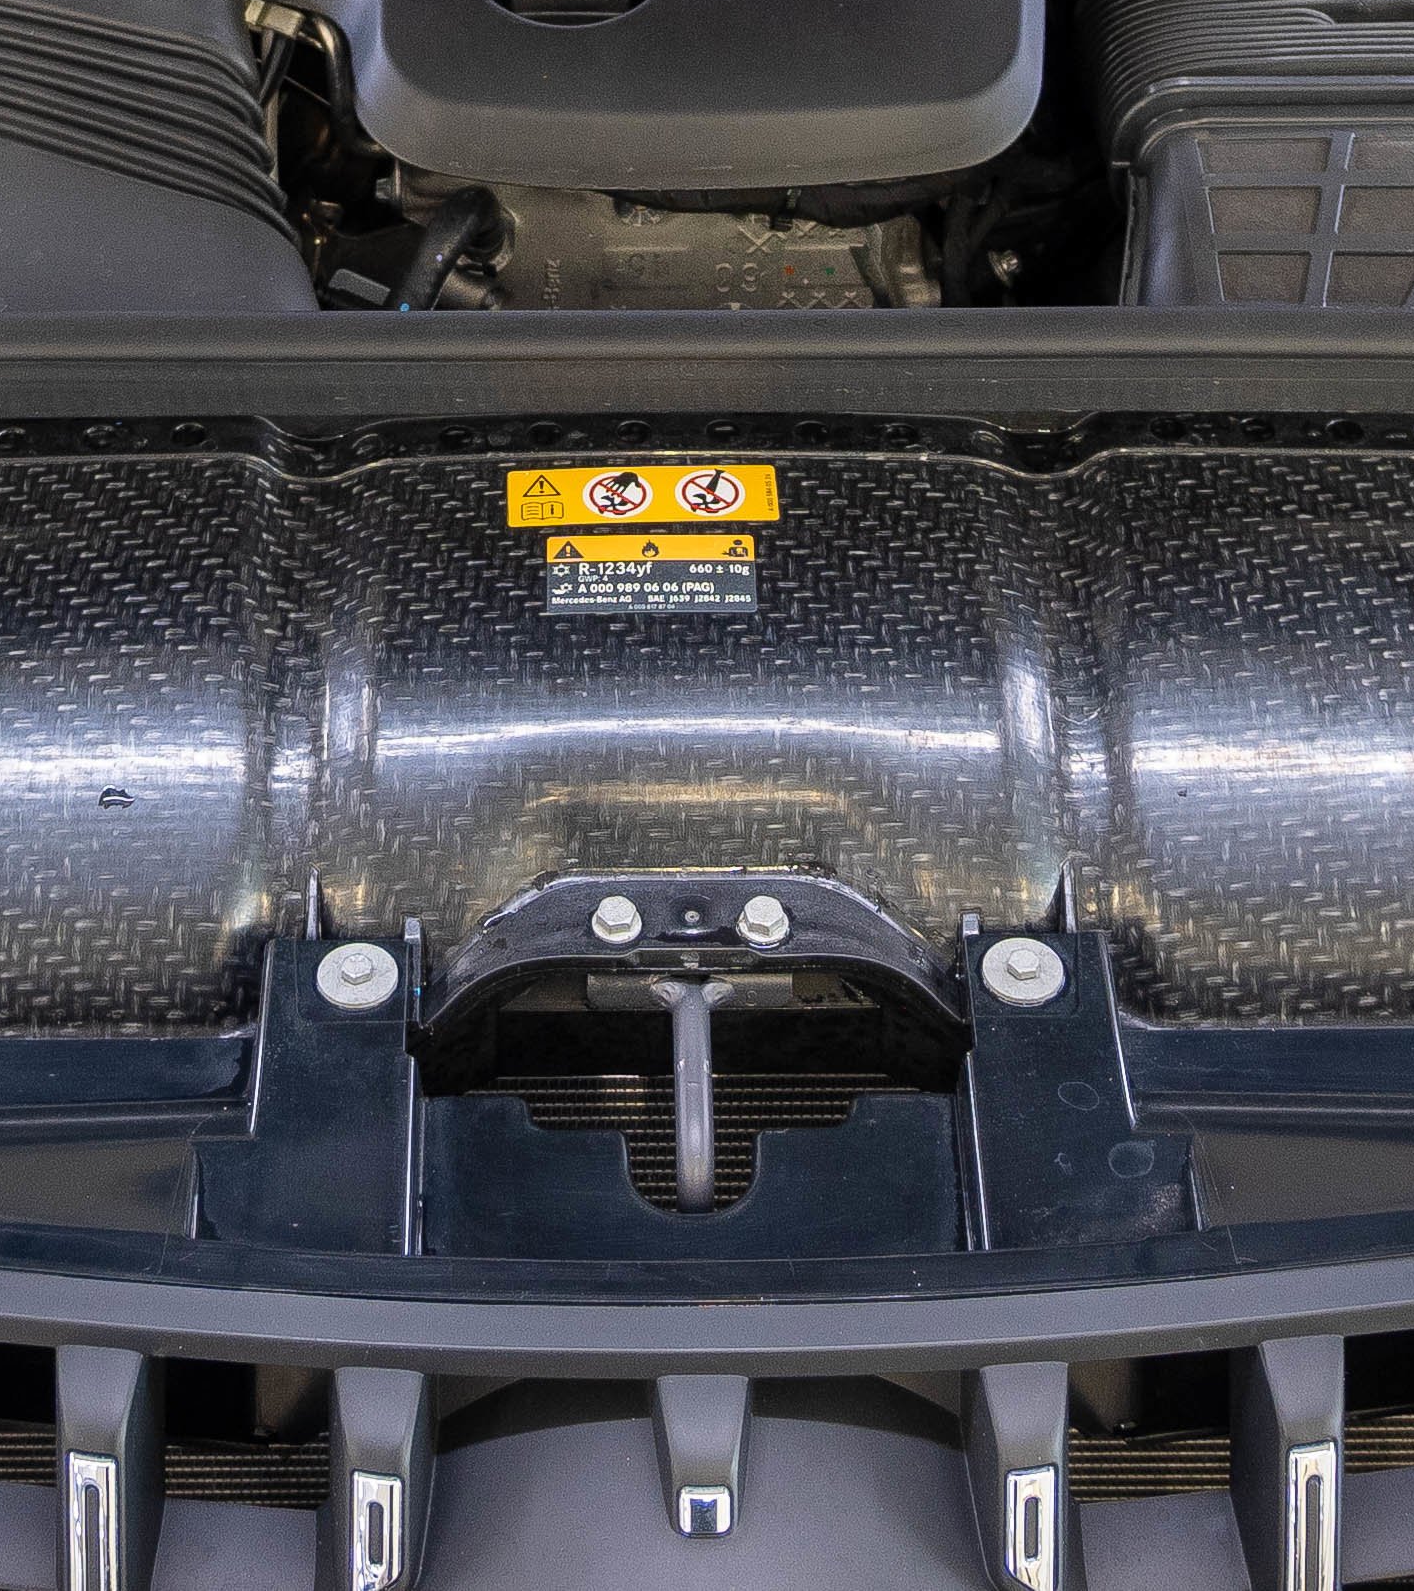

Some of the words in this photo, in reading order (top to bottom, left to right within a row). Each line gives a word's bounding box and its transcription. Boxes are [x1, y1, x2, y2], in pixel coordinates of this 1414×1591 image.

[578, 561, 653, 577] R-1234yf
[689, 563, 713, 574] 660
[728, 563, 750, 576] 10g
[602, 575, 608, 583] 4
[578, 583, 587, 593] A
[590, 583, 614, 593] 000
[616, 583, 641, 593] 989
[643, 582, 660, 593] 06
[662, 582, 679, 593] 06
[681, 581, 715, 594] (PAG)
[551, 595, 618, 605] Mercedes-Benz
[618, 595, 633, 603] AG
